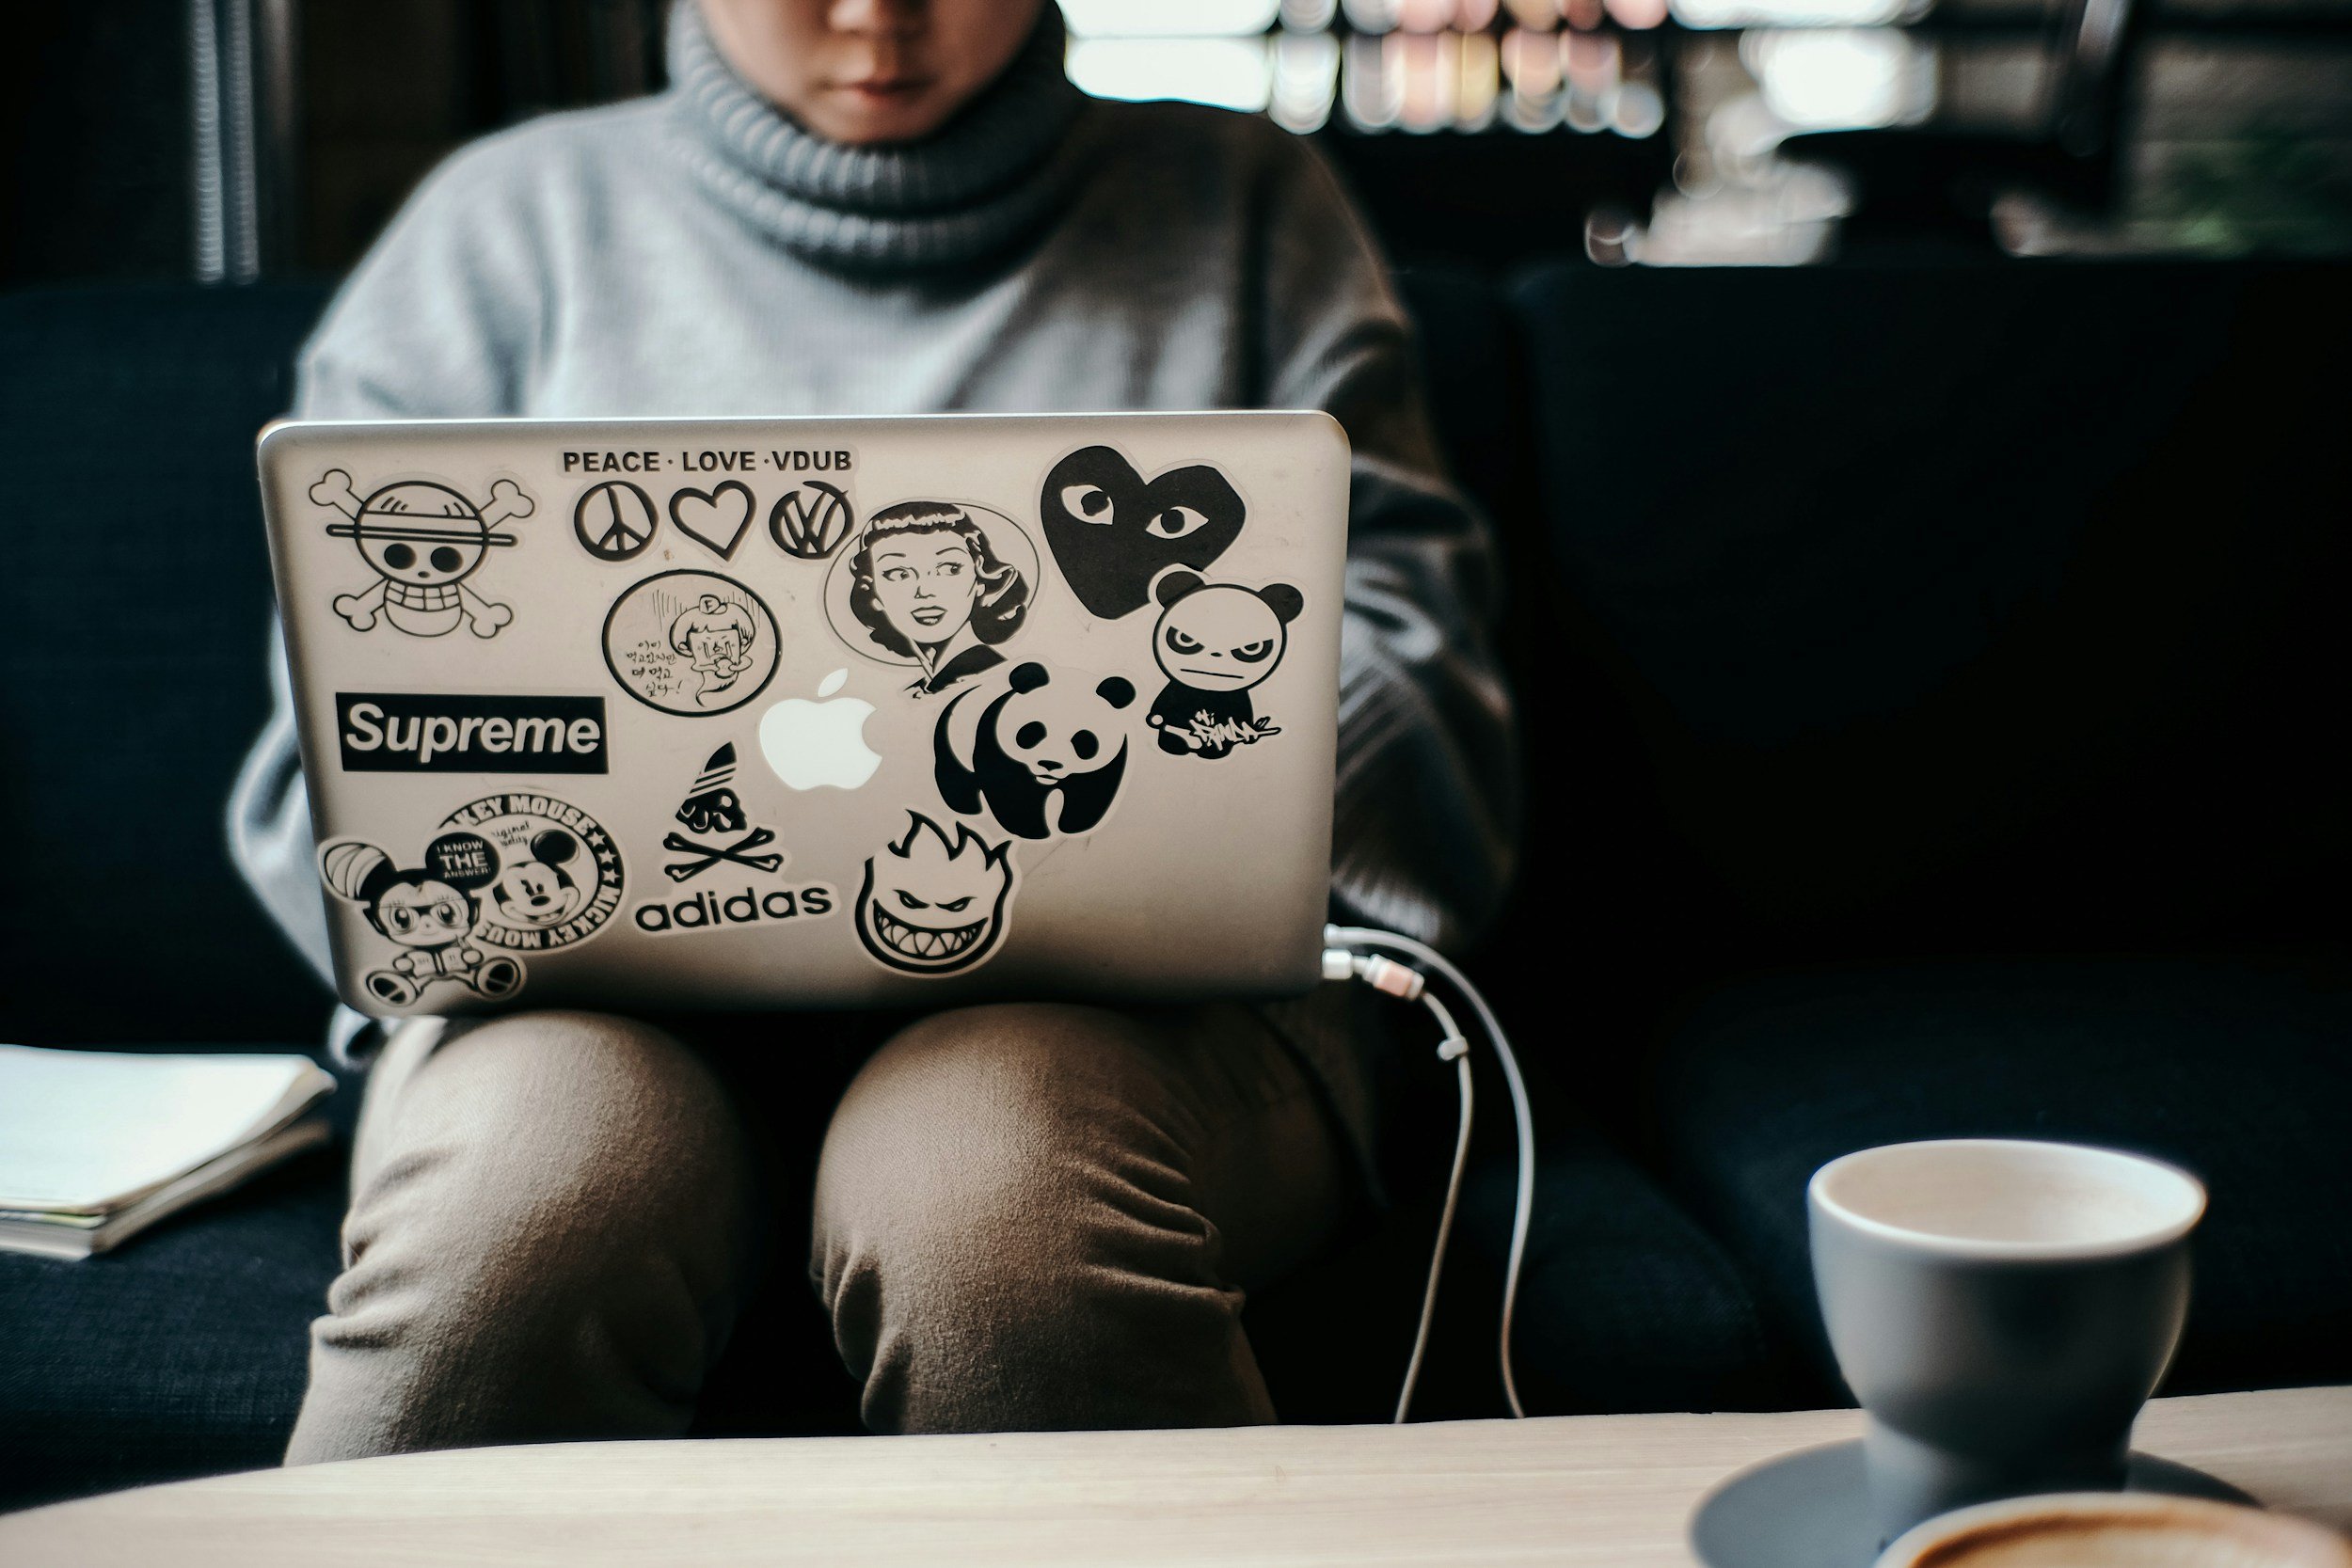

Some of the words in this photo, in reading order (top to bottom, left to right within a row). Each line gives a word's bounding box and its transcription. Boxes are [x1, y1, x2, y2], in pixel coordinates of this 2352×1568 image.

[564, 451, 660, 472] PEACE
[682, 451, 756, 471] LOVE
[771, 451, 852, 471] VDUB
[346, 703, 600, 764] Supreme
[452, 797, 504, 827] KEY
[509, 795, 597, 835] MOUSE
[437, 845, 441, 853] I
[443, 840, 484, 853] KNOW
[439, 852, 488, 871] THE
[548, 884, 622, 948] MICKEY
[635, 887, 833, 932] adidas
[473, 922, 543, 949] MOUS
